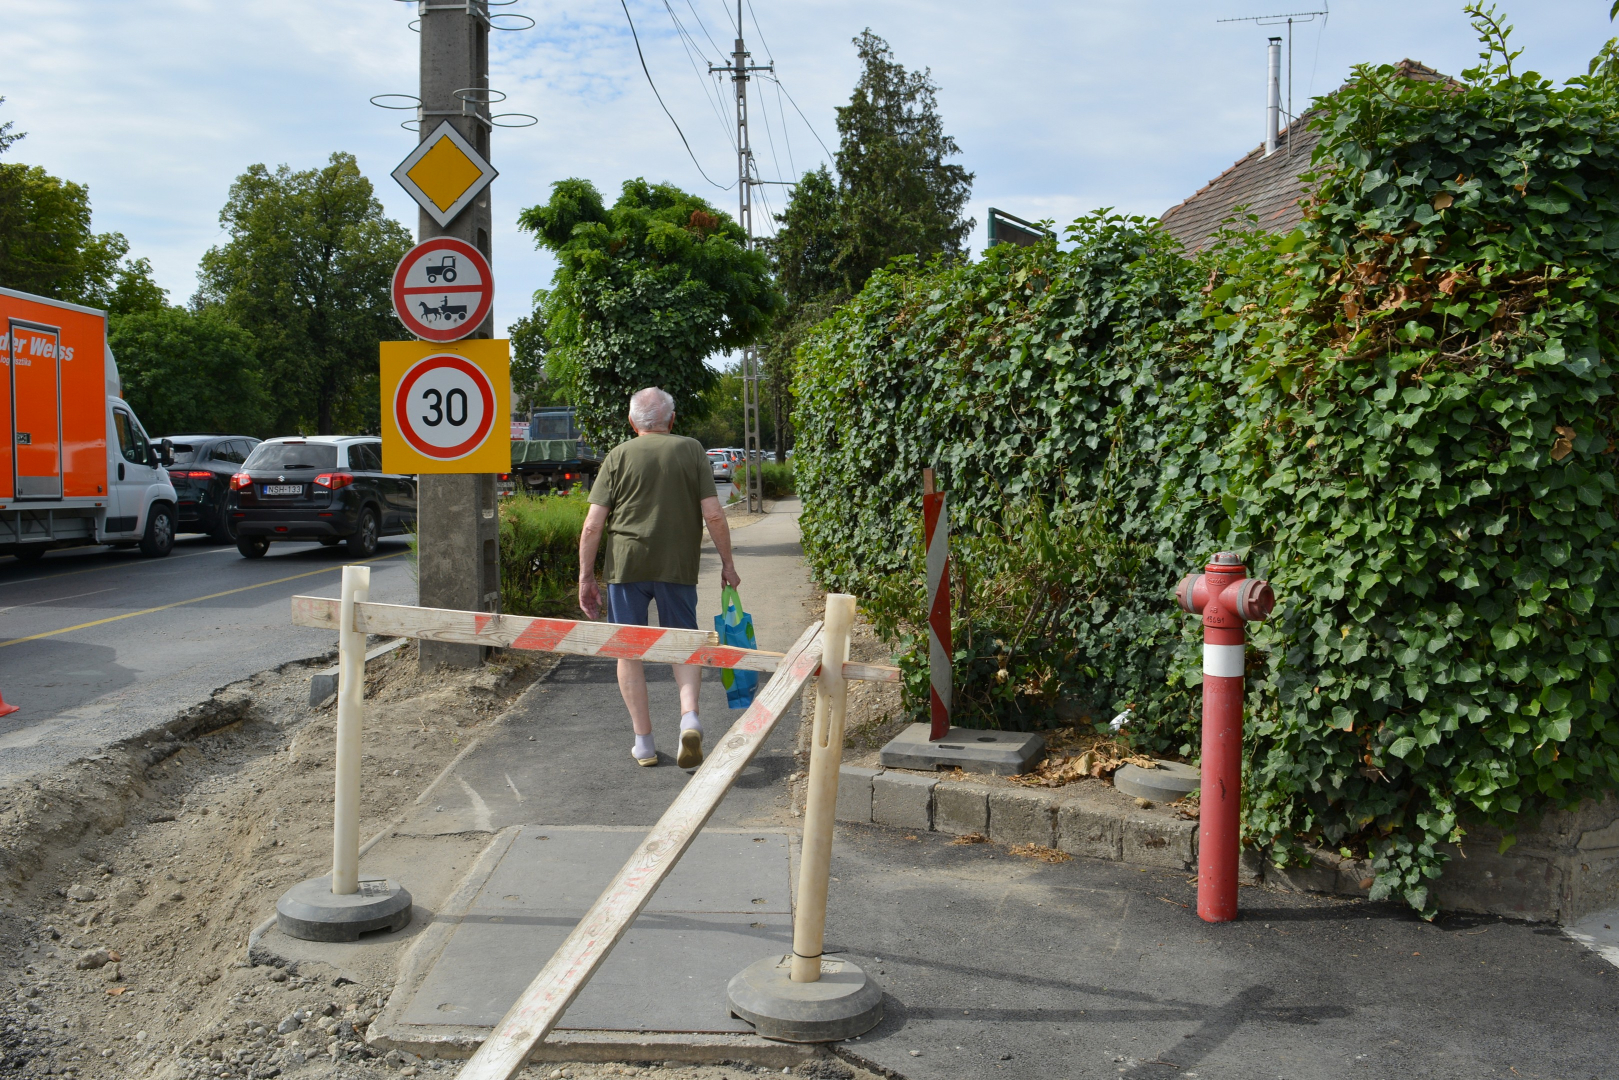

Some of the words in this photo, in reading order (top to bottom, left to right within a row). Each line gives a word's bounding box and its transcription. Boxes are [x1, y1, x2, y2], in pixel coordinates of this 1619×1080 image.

[30, 336, 75, 361] Weiss
[422, 388, 468, 427] 30
[268, 485, 301, 494] NSH-133
